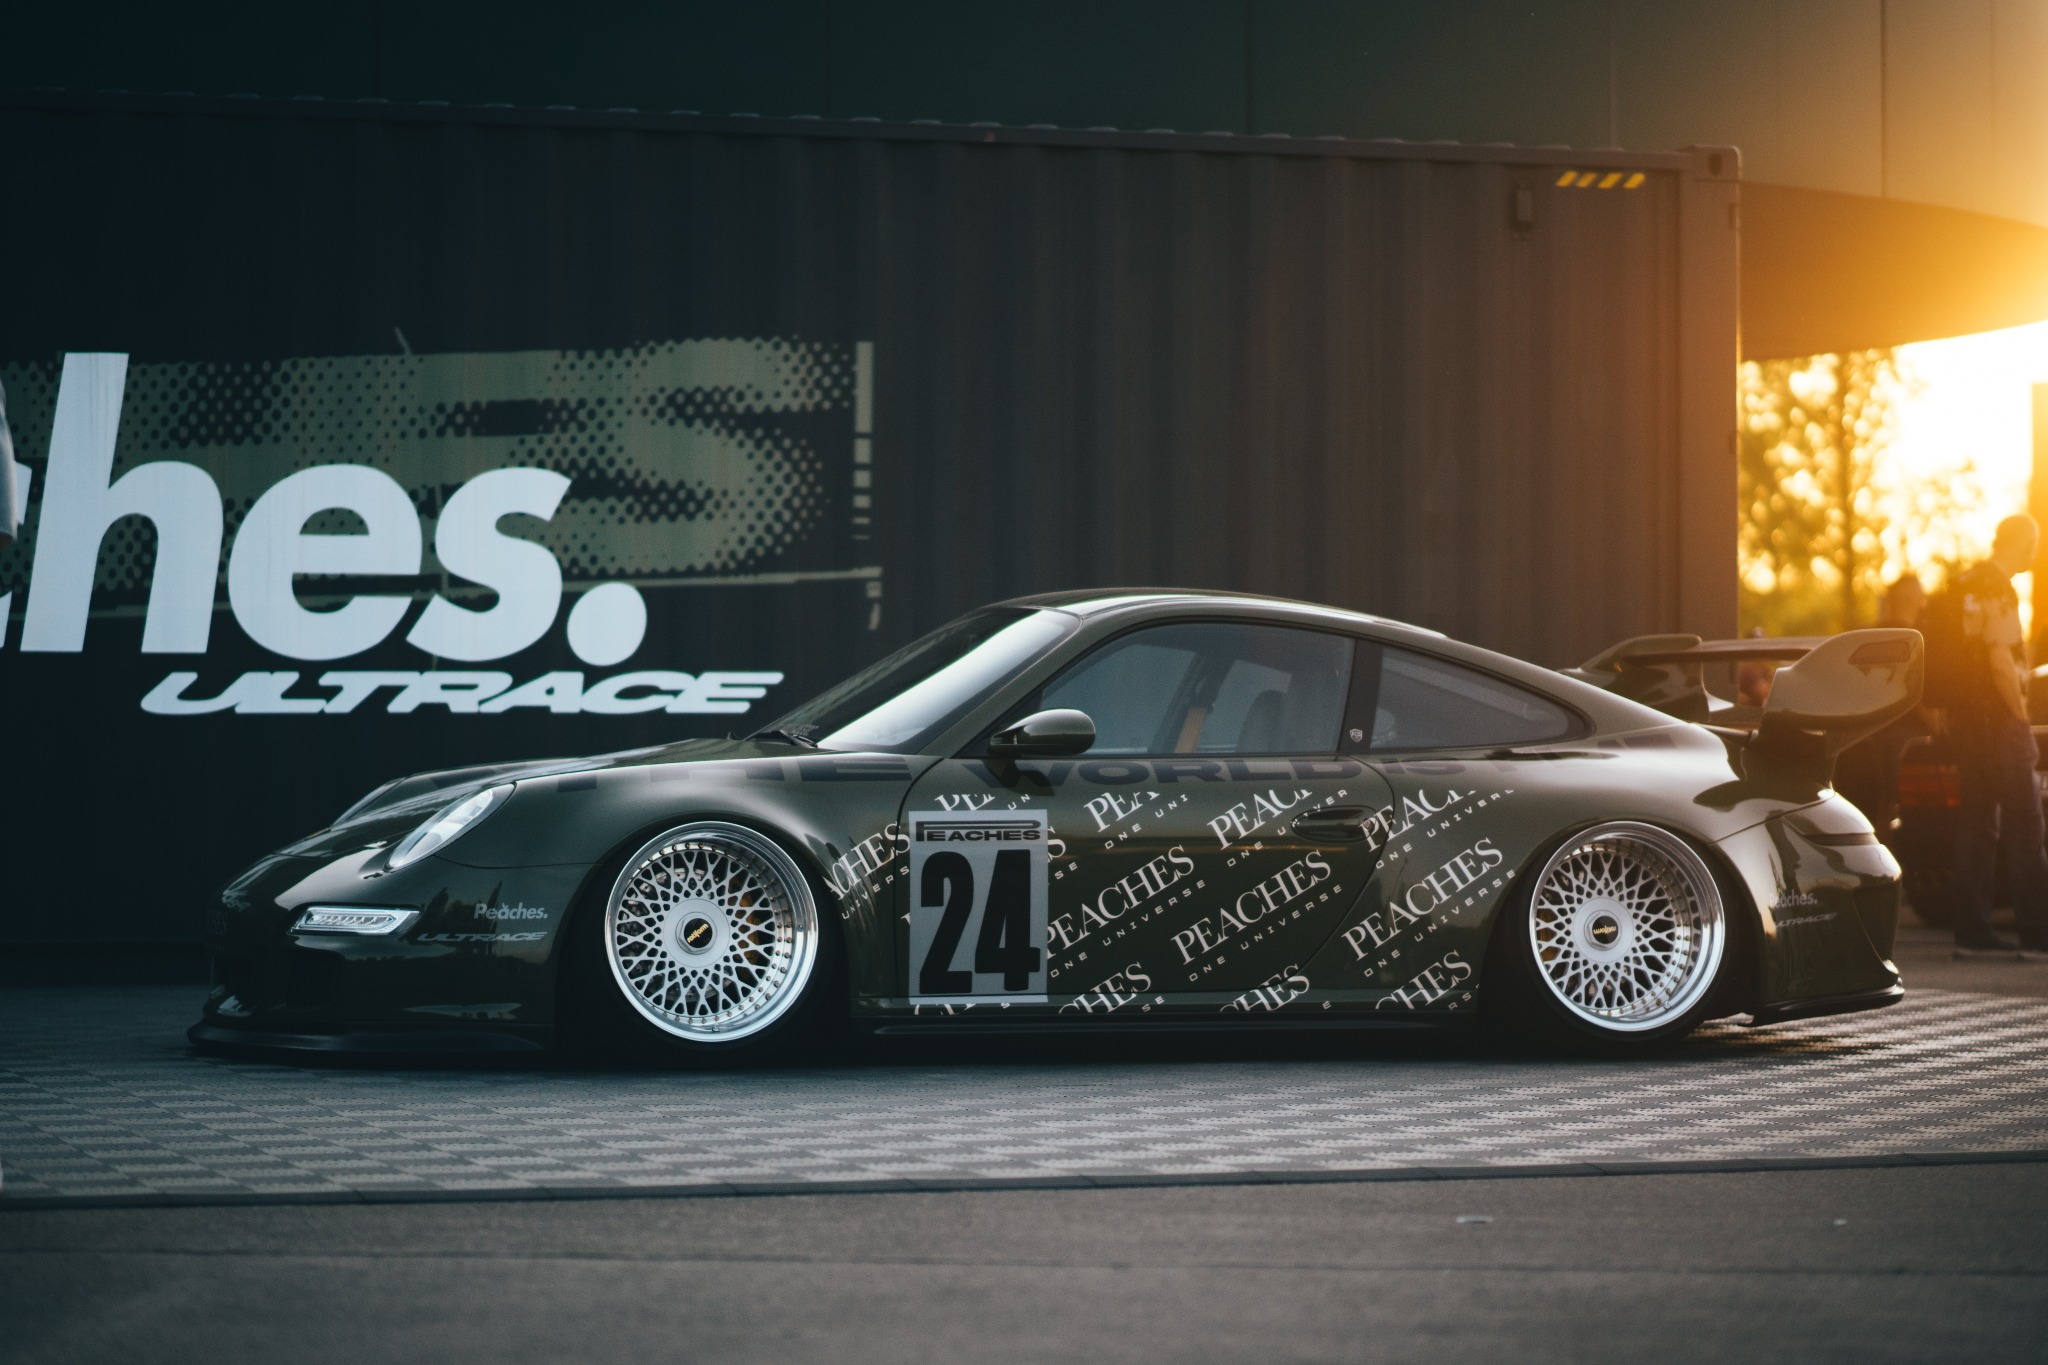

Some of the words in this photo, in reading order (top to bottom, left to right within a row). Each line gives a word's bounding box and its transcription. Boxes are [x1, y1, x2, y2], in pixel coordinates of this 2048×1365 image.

[141, 671, 784, 714] ULTRACE
[961, 761, 1361, 788] WORLD
[916, 820, 1041, 841] PEACHES
[1104, 823, 1142, 850] ONE
[1207, 789, 1313, 851] PEAC
[1358, 789, 1477, 853] PEAC
[1227, 841, 1264, 867] ONE
[1375, 842, 1413, 870] ONE
[841, 865, 910, 920] UNIVERS
[1170, 849, 1331, 966] PEACHES
[1341, 836, 1503, 961] PEACHES
[1775, 912, 1838, 928] LTRACE
[416, 931, 548, 942] ULTRACE
[919, 849, 1041, 994] 24
[1050, 951, 1088, 978] ONE
[1102, 879, 1206, 947] UNIVERSE
[1189, 955, 1226, 982] ONE
[1240, 884, 1342, 950] UNIVERSE
[1363, 949, 1401, 978] ONE
[1414, 869, 1516, 942] UNIVERSE
